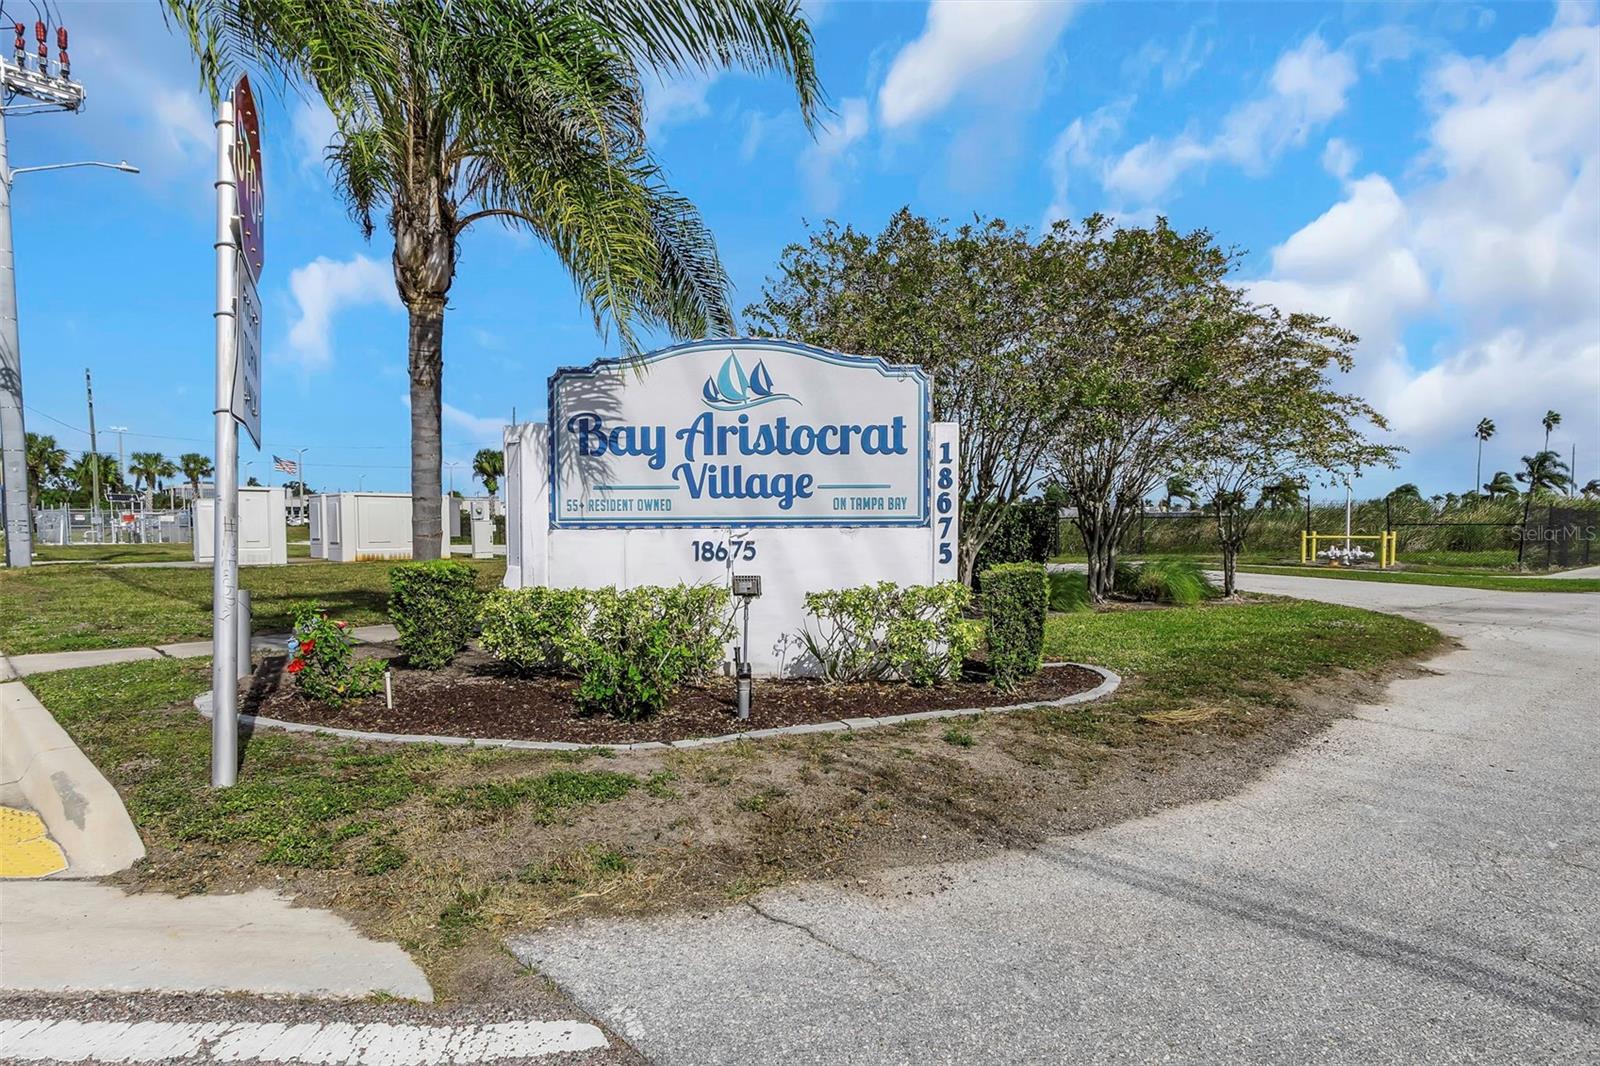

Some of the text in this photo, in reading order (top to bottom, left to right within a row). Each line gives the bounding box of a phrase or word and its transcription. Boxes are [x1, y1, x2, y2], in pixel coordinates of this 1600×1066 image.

[237, 109, 263, 239] STOP
[566, 411, 908, 470] Bay Aristocrat
[566, 498, 672, 512] 55+ RESIDENT OWNED
[671, 462, 814, 510] Village
[832, 497, 908, 510] ON TAMPA BAY
[937, 442, 953, 564] 18675
[691, 540, 757, 562] 18675
